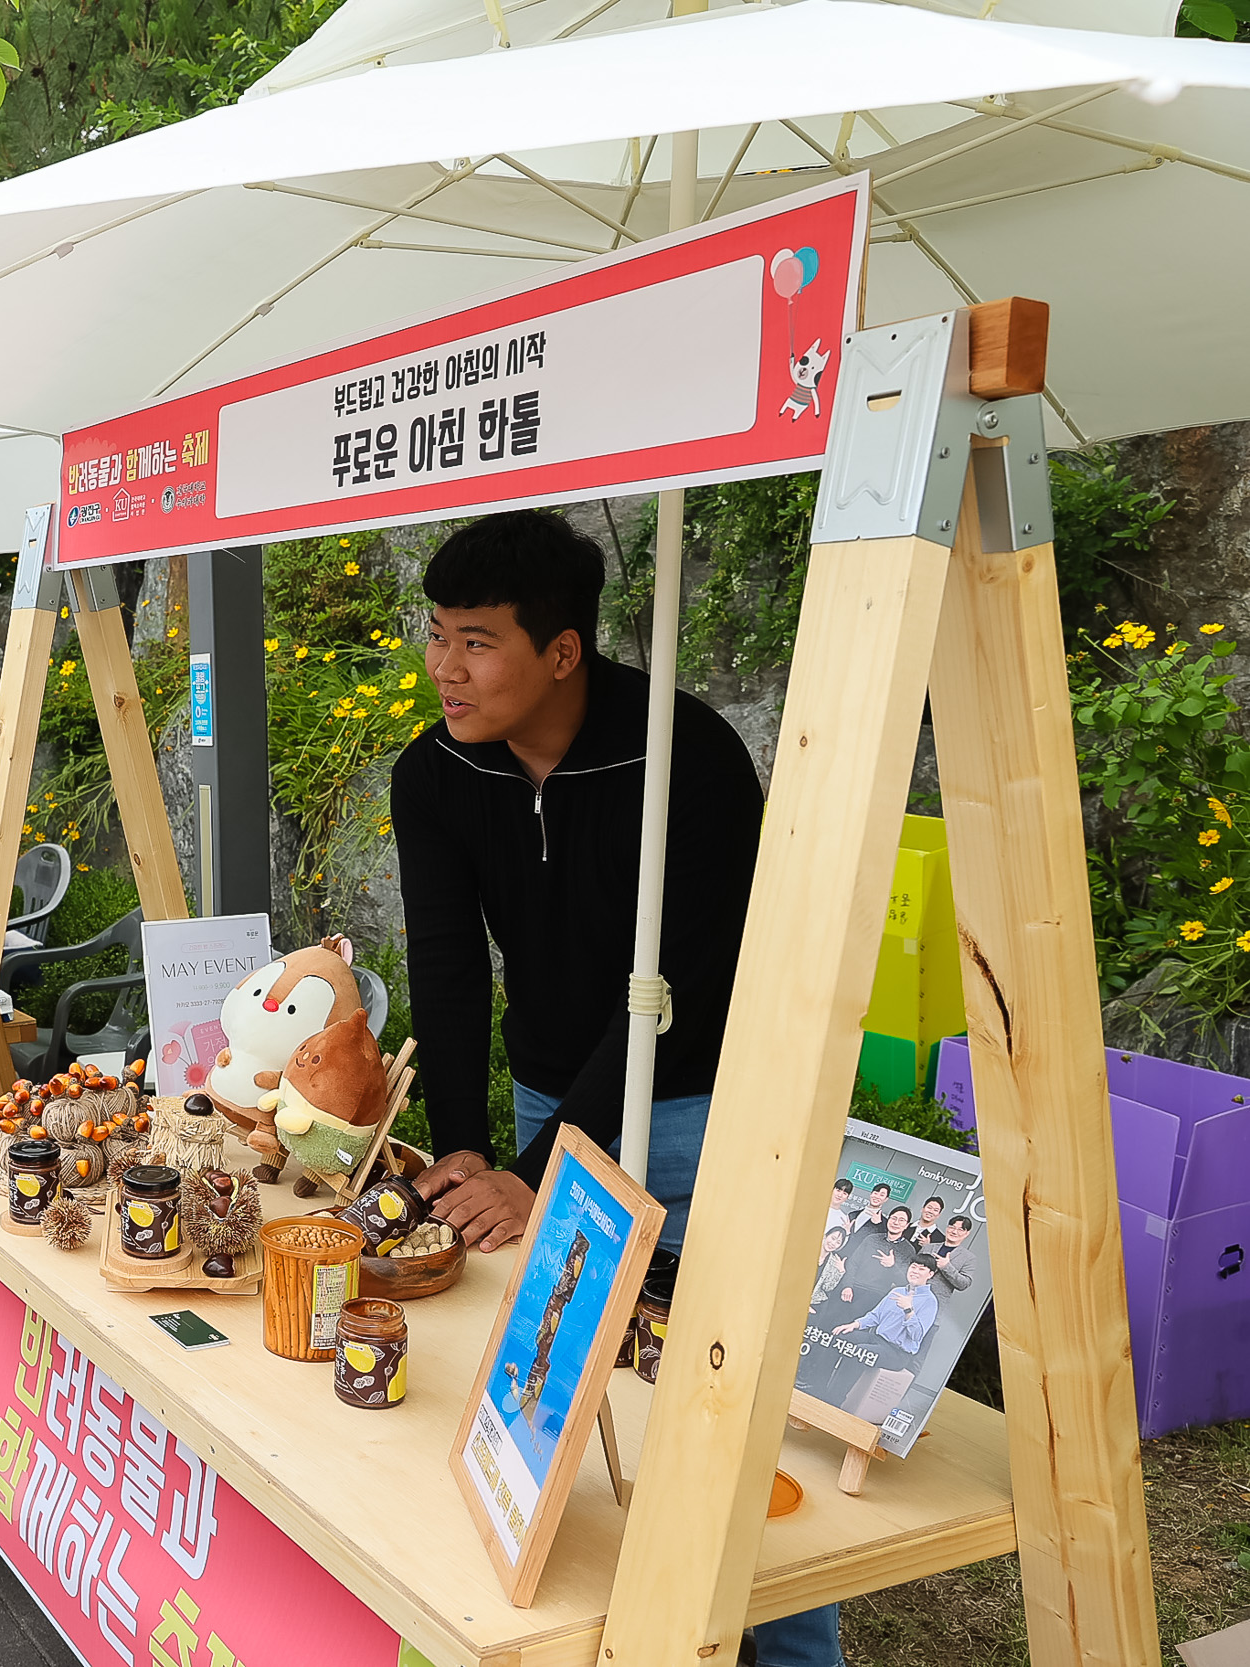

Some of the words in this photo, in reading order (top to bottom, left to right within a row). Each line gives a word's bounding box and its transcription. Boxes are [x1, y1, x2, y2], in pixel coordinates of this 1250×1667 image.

[334, 374, 385, 418] 부드럽고
[391, 359, 439, 404] 건강한
[445, 343, 500, 390] 아침의
[505, 330, 547, 377] 시작
[332, 423, 398, 488] 푸로운
[409, 407, 466, 473] 아침
[478, 390, 541, 462] 한톨
[68, 452, 123, 495] 반려동물과
[126, 440, 177, 482] 함께하는
[181, 429, 209, 468] 축제
[80, 503, 101, 517] 광진구
[115, 498, 128, 512] KU
[161, 961, 199, 979] MAY
[204, 956, 256, 975] EVENT
[852, 1168, 877, 1184] KU
[917, 1165, 964, 1191] hankyung
[833, 1338, 879, 1367] 지원사업
[14, 1303, 218, 1580] 반려동물과
